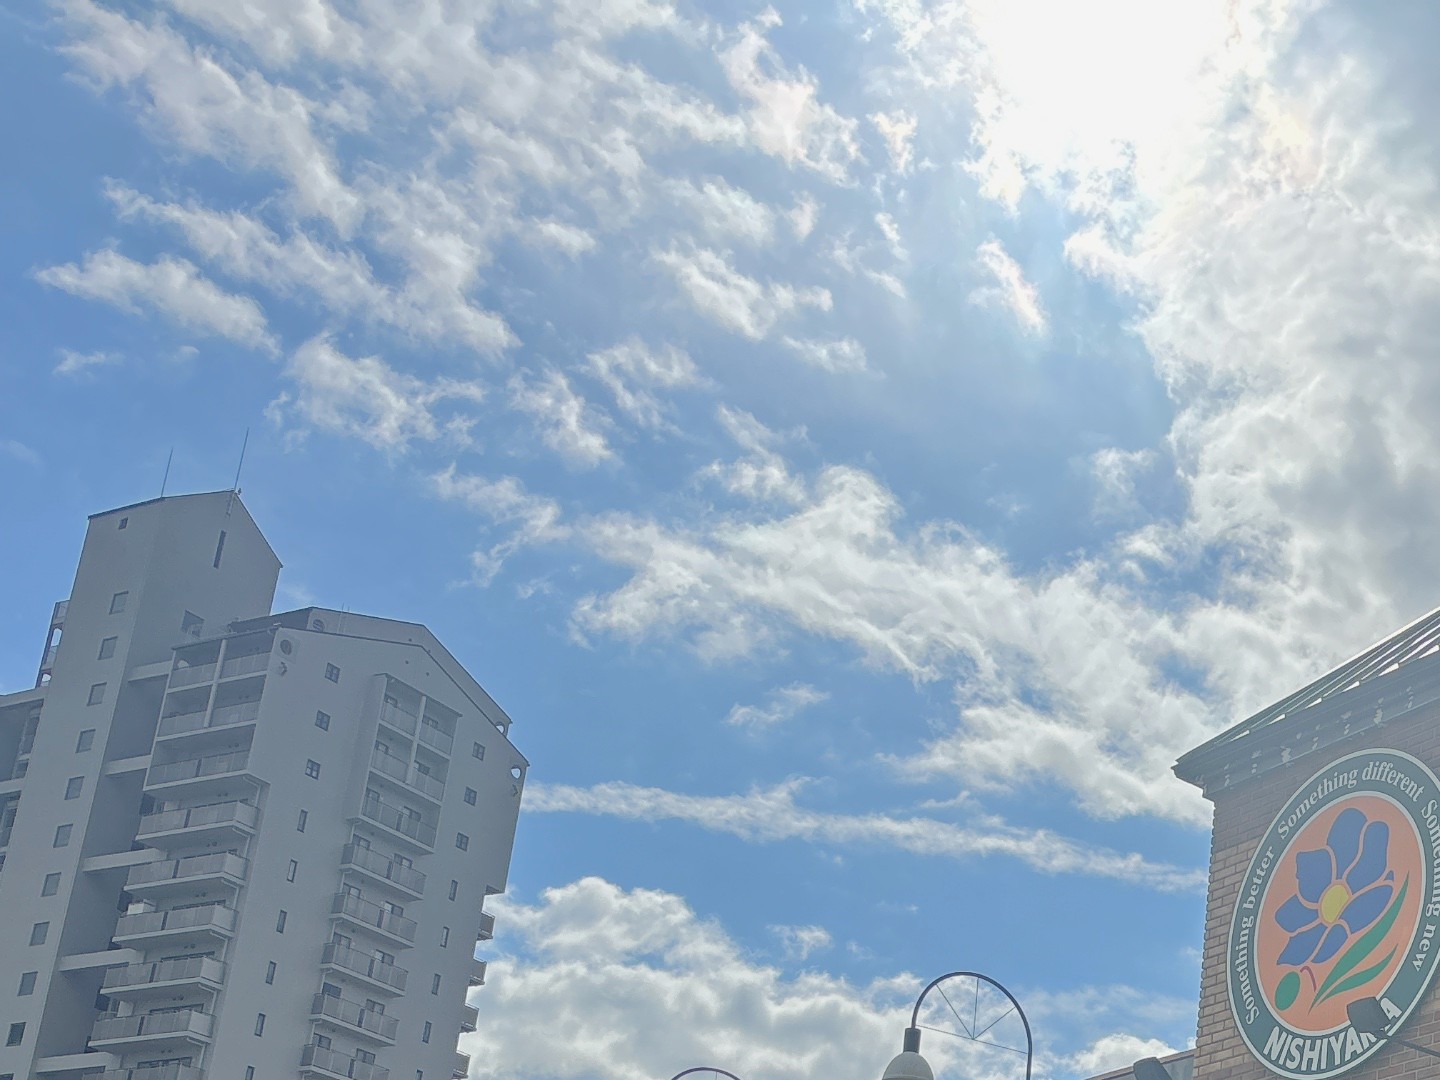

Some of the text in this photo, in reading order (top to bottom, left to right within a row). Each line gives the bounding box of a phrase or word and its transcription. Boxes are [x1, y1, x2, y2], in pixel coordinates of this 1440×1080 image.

[1277, 768, 1359, 840] Something
[1361, 761, 1425, 802] different
[1243, 846, 1275, 910] better
[1235, 915, 1260, 1025] Something
[1412, 921, 1437, 973] new
